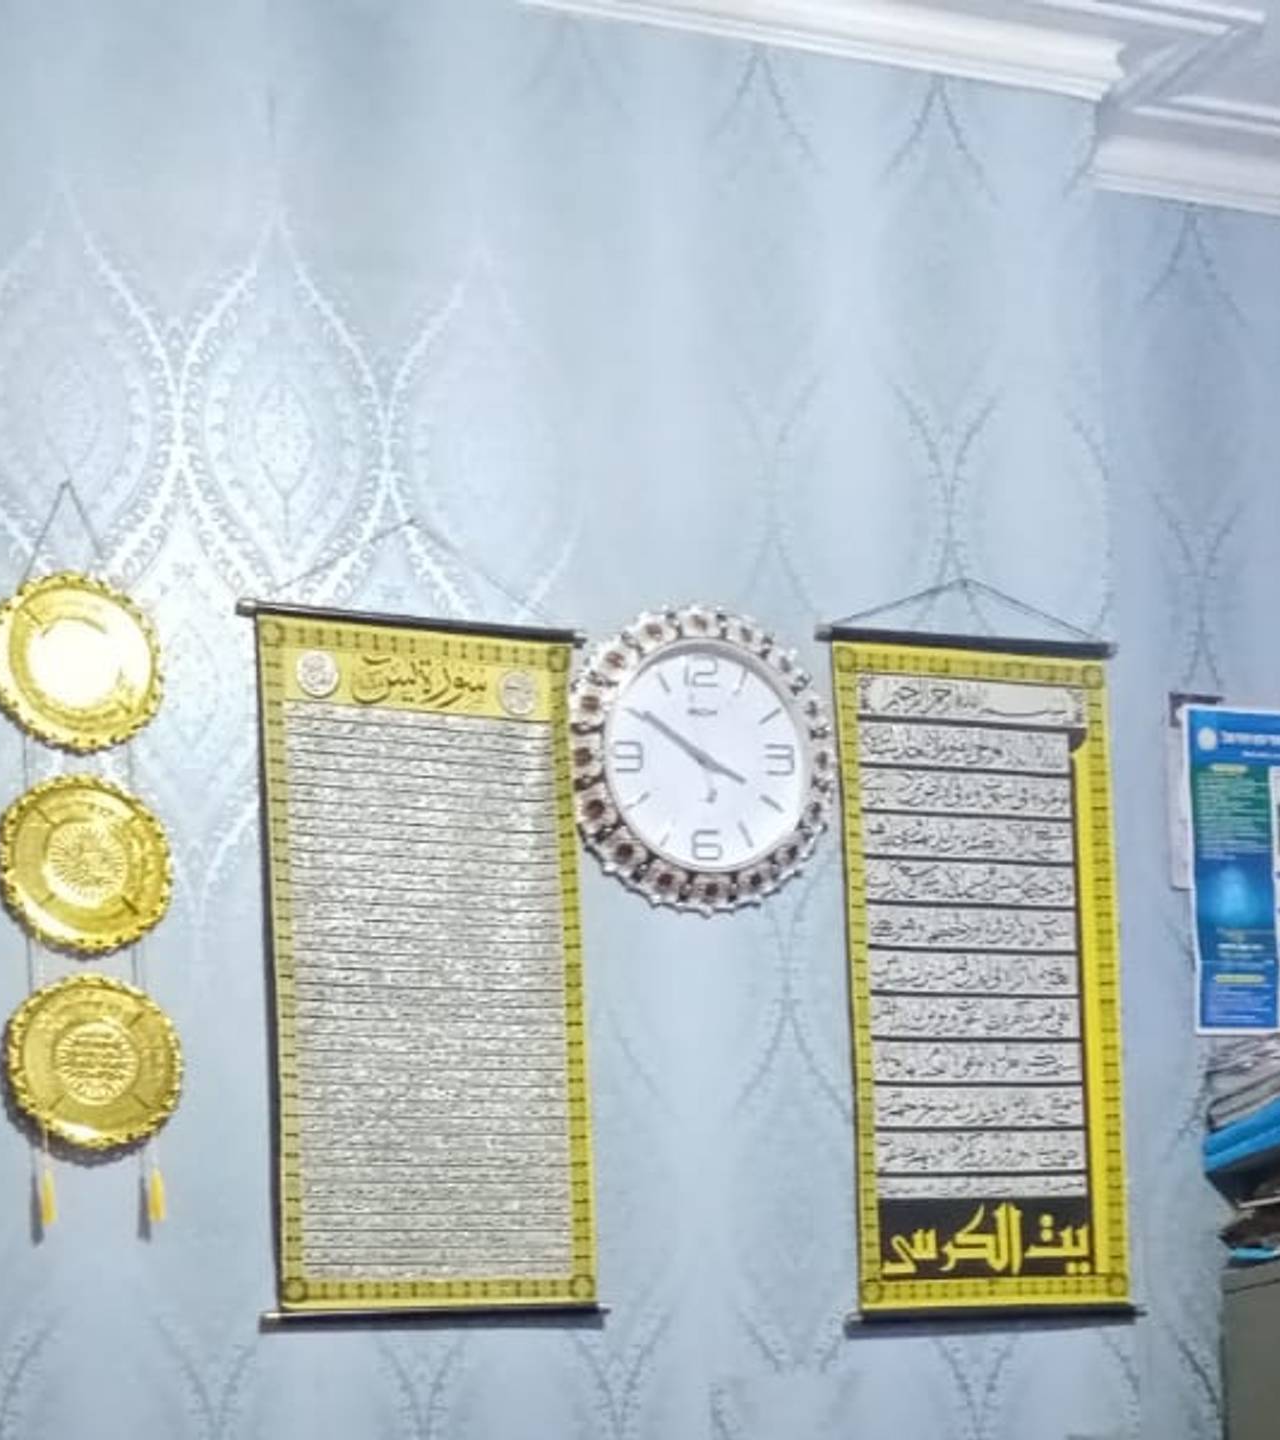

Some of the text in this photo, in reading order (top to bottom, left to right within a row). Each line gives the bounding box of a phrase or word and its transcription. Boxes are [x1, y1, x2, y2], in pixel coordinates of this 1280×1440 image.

[683, 656, 719, 688] 12
[764, 743, 795, 776] 3
[691, 829, 723, 860] 6
